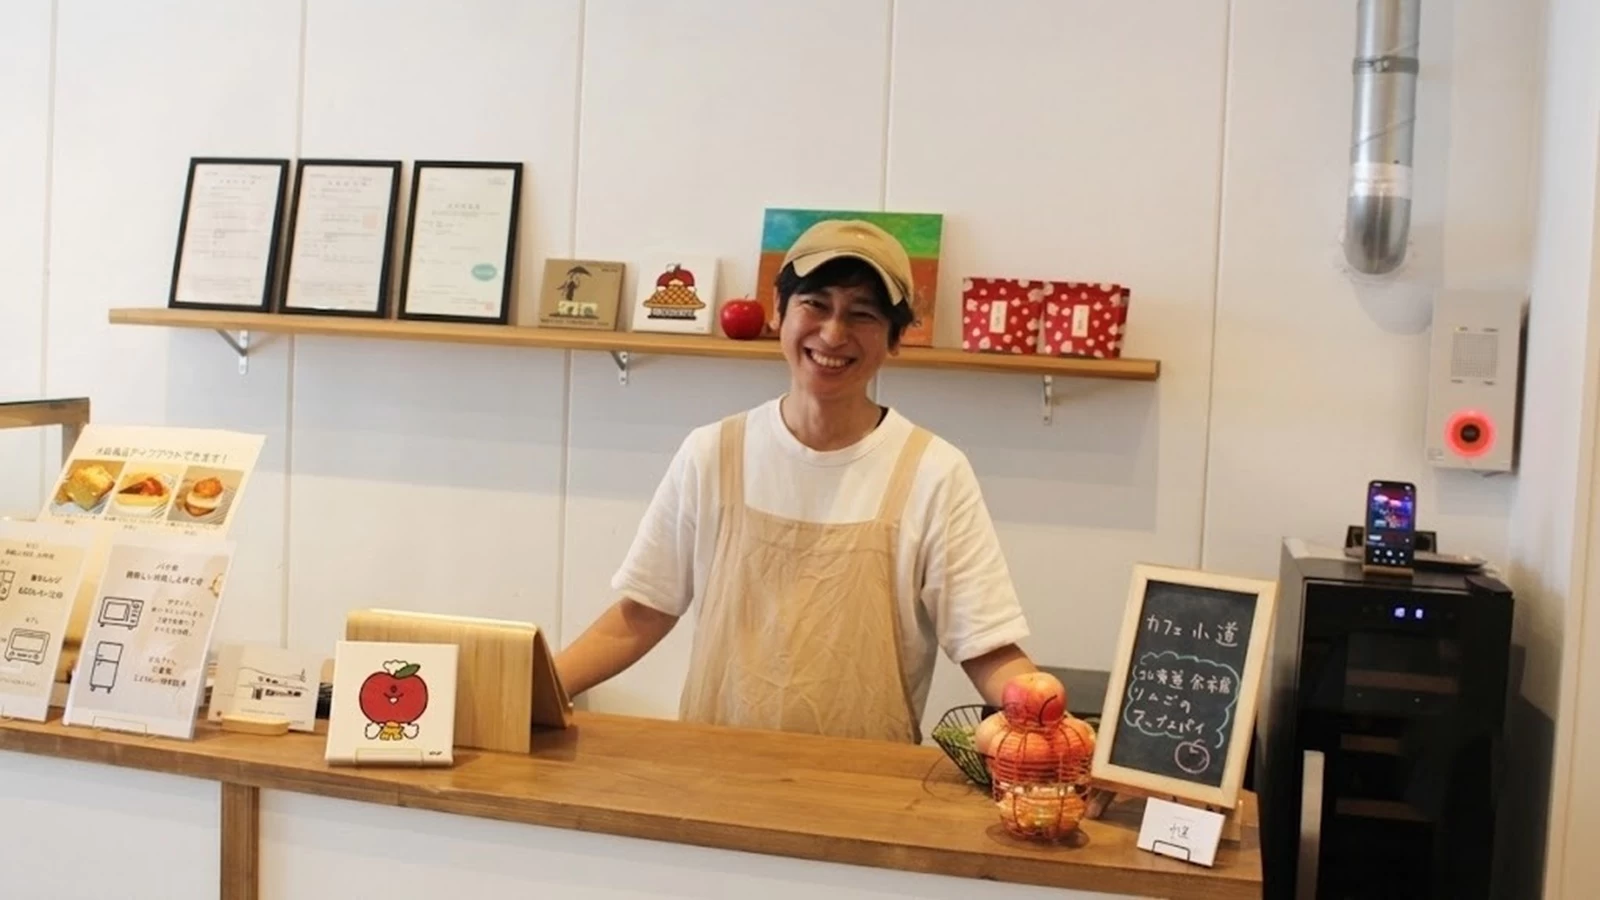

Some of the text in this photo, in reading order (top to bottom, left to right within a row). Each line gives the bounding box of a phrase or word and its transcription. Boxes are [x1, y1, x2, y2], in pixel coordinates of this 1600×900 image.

[1147, 614, 1239, 648] カフェ 小道
